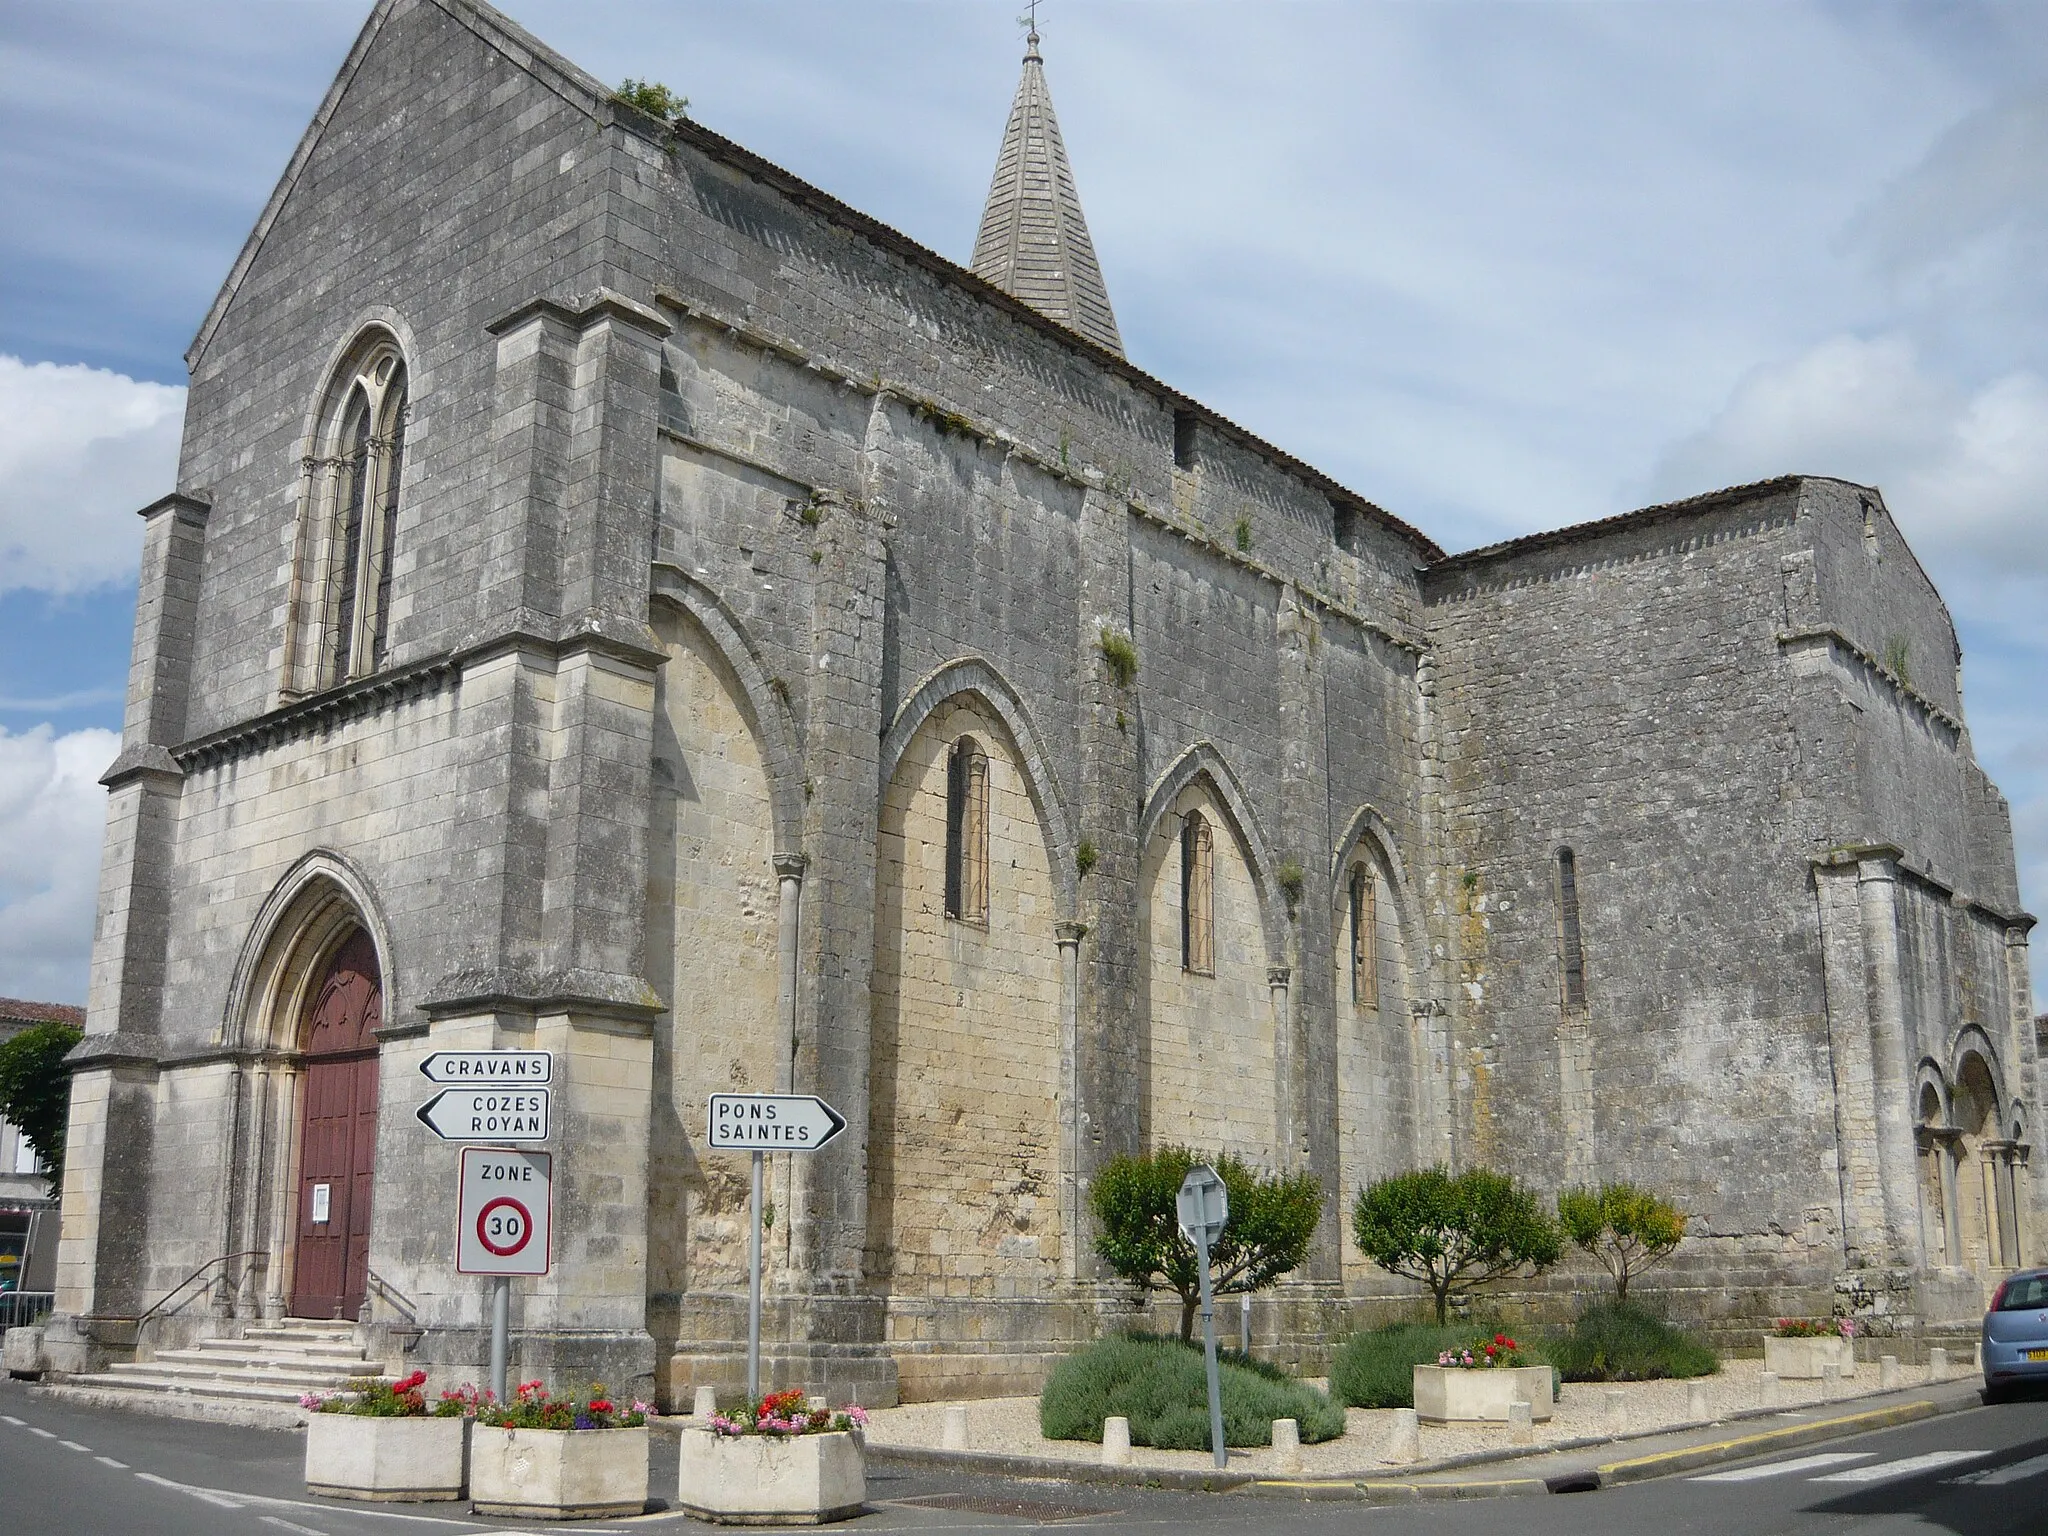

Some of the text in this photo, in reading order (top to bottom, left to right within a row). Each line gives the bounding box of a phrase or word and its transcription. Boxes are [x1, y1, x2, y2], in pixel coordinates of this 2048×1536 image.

[445, 1060, 542, 1075] CRAVANS
[473, 1097, 540, 1111] COZES
[719, 1103, 777, 1120] PONS
[471, 1116, 540, 1131] ROYAN
[719, 1124, 809, 1140] SAINTES
[481, 1164, 533, 1181] ZONE
[490, 1217, 520, 1236] 30
